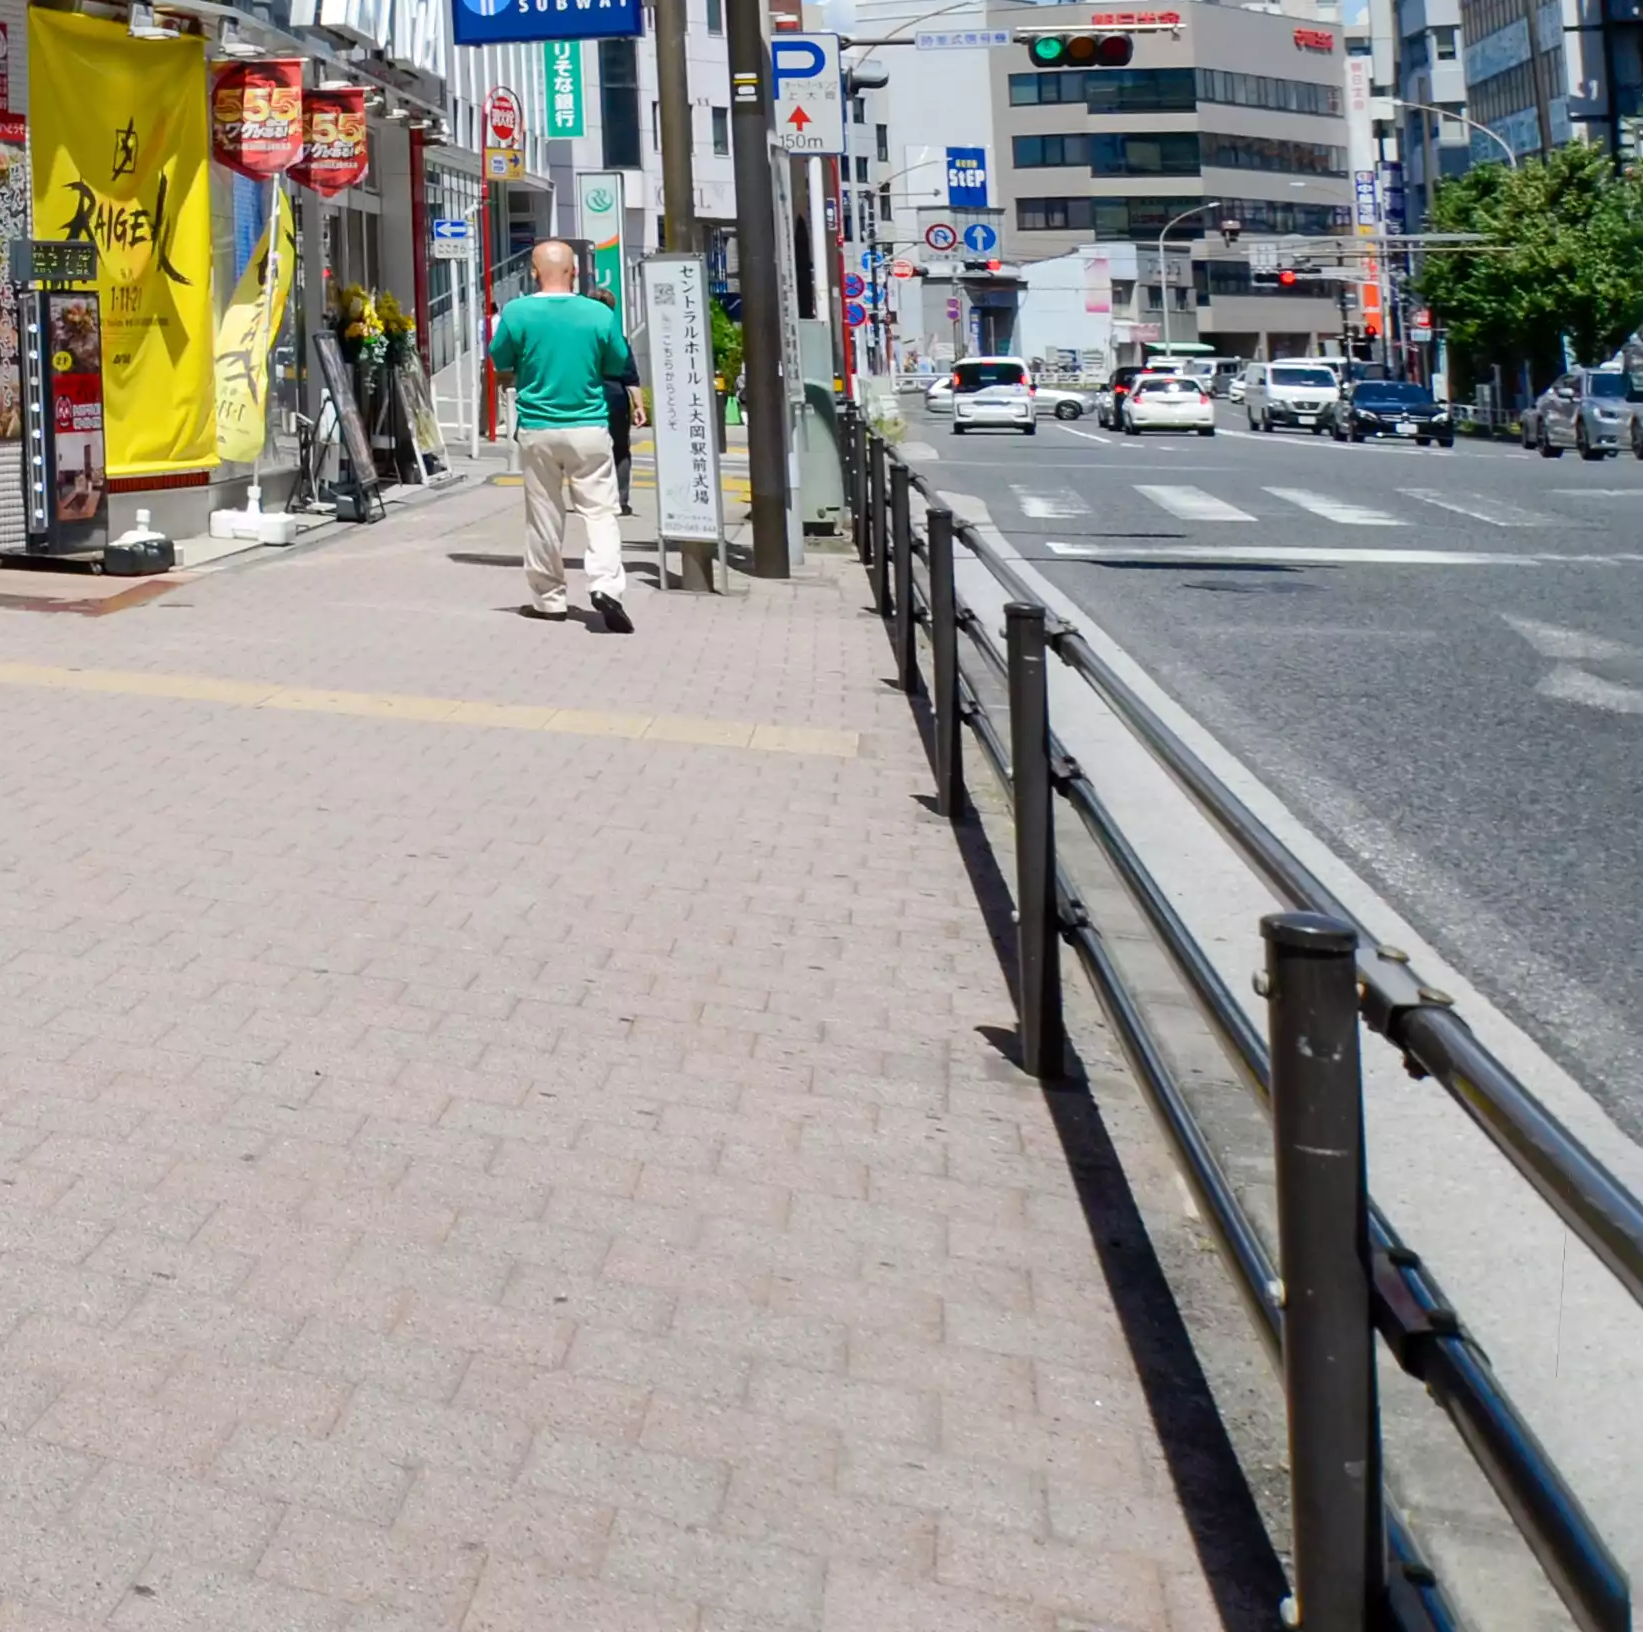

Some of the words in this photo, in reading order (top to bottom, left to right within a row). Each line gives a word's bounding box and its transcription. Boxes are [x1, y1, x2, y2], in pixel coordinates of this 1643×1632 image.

[771, 40, 826, 100] P
[778, 133, 824, 149] 150m
[679, 265, 703, 386] セントラルホール
